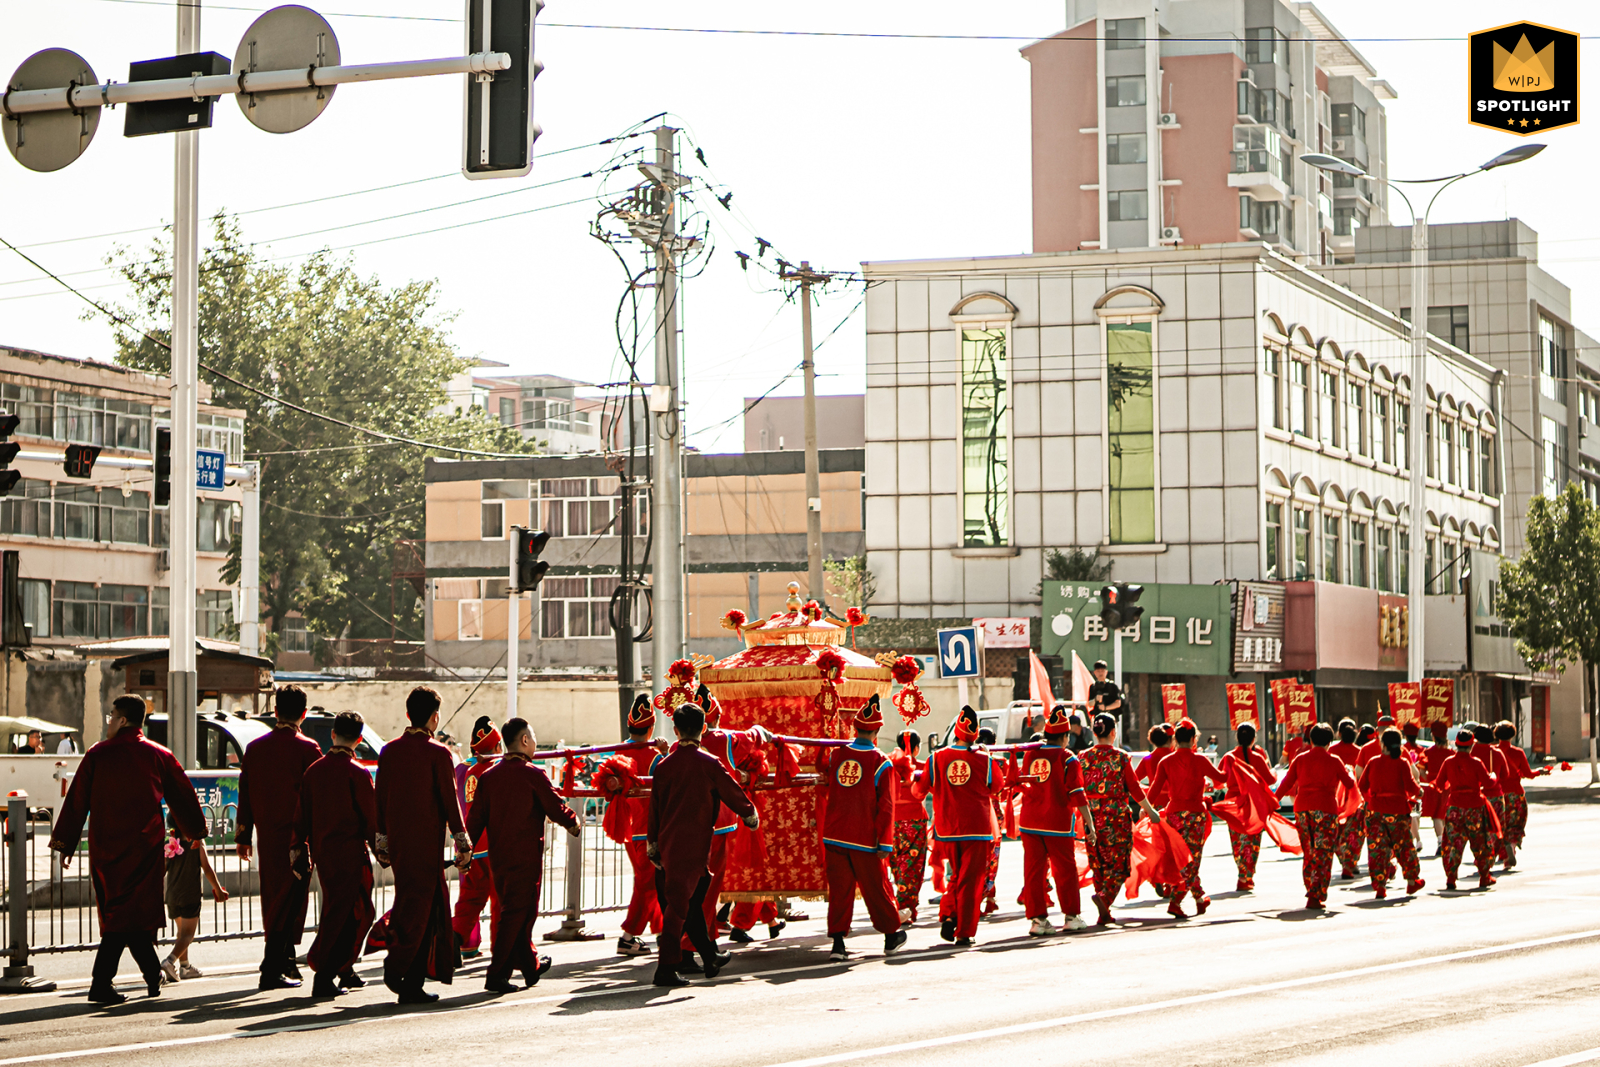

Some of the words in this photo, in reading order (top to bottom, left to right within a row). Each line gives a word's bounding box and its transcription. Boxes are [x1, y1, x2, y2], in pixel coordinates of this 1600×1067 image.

[197, 455, 221, 470] 信号灯
[195, 787, 222, 807] 运动
